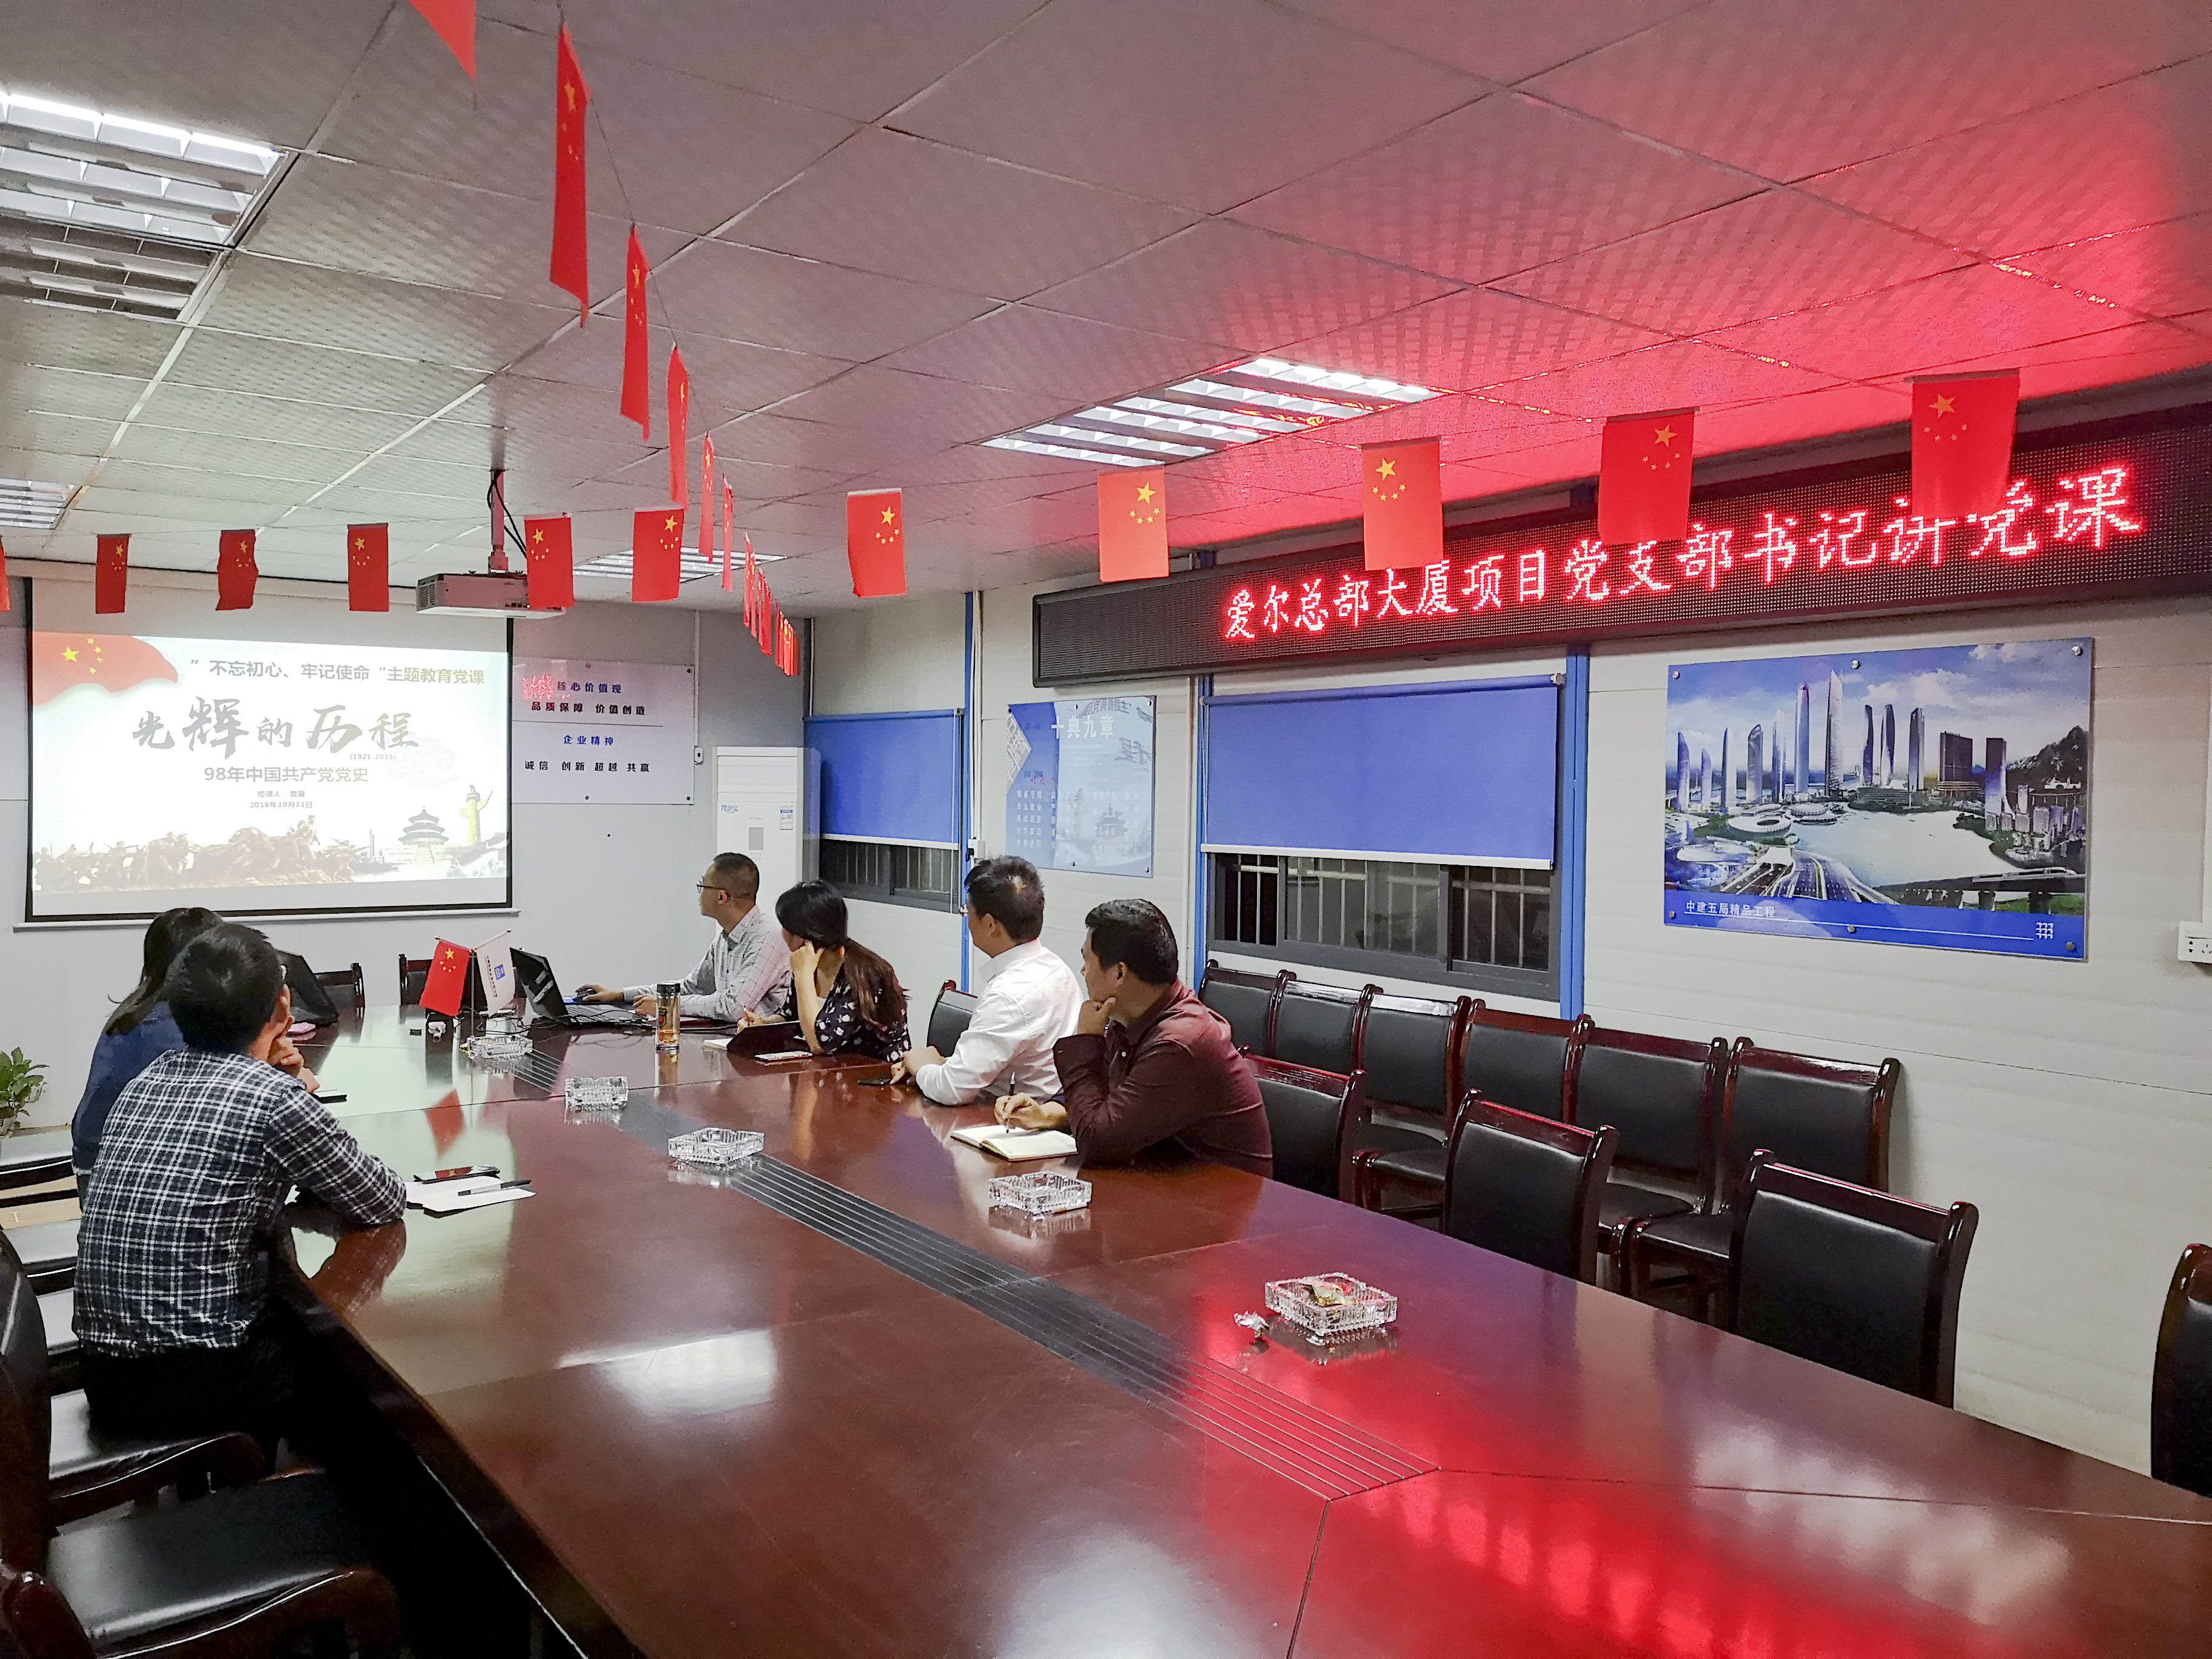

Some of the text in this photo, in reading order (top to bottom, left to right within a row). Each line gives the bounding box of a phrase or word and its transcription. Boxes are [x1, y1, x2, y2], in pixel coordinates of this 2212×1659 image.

[557, 681, 622, 694] 核心价值观
[531, 702, 646, 716] 品质保障 价值创造
[132, 695, 420, 760] 光辉的历程
[1051, 714, 1114, 740] 十典九章
[563, 735, 614, 746] 企业精神
[525, 760, 649, 773] 诚信 创新 超越 共赢
[204, 766, 369, 783] 98年中国共产党党史
[1686, 900, 1775, 918] 中建五局精品工程
